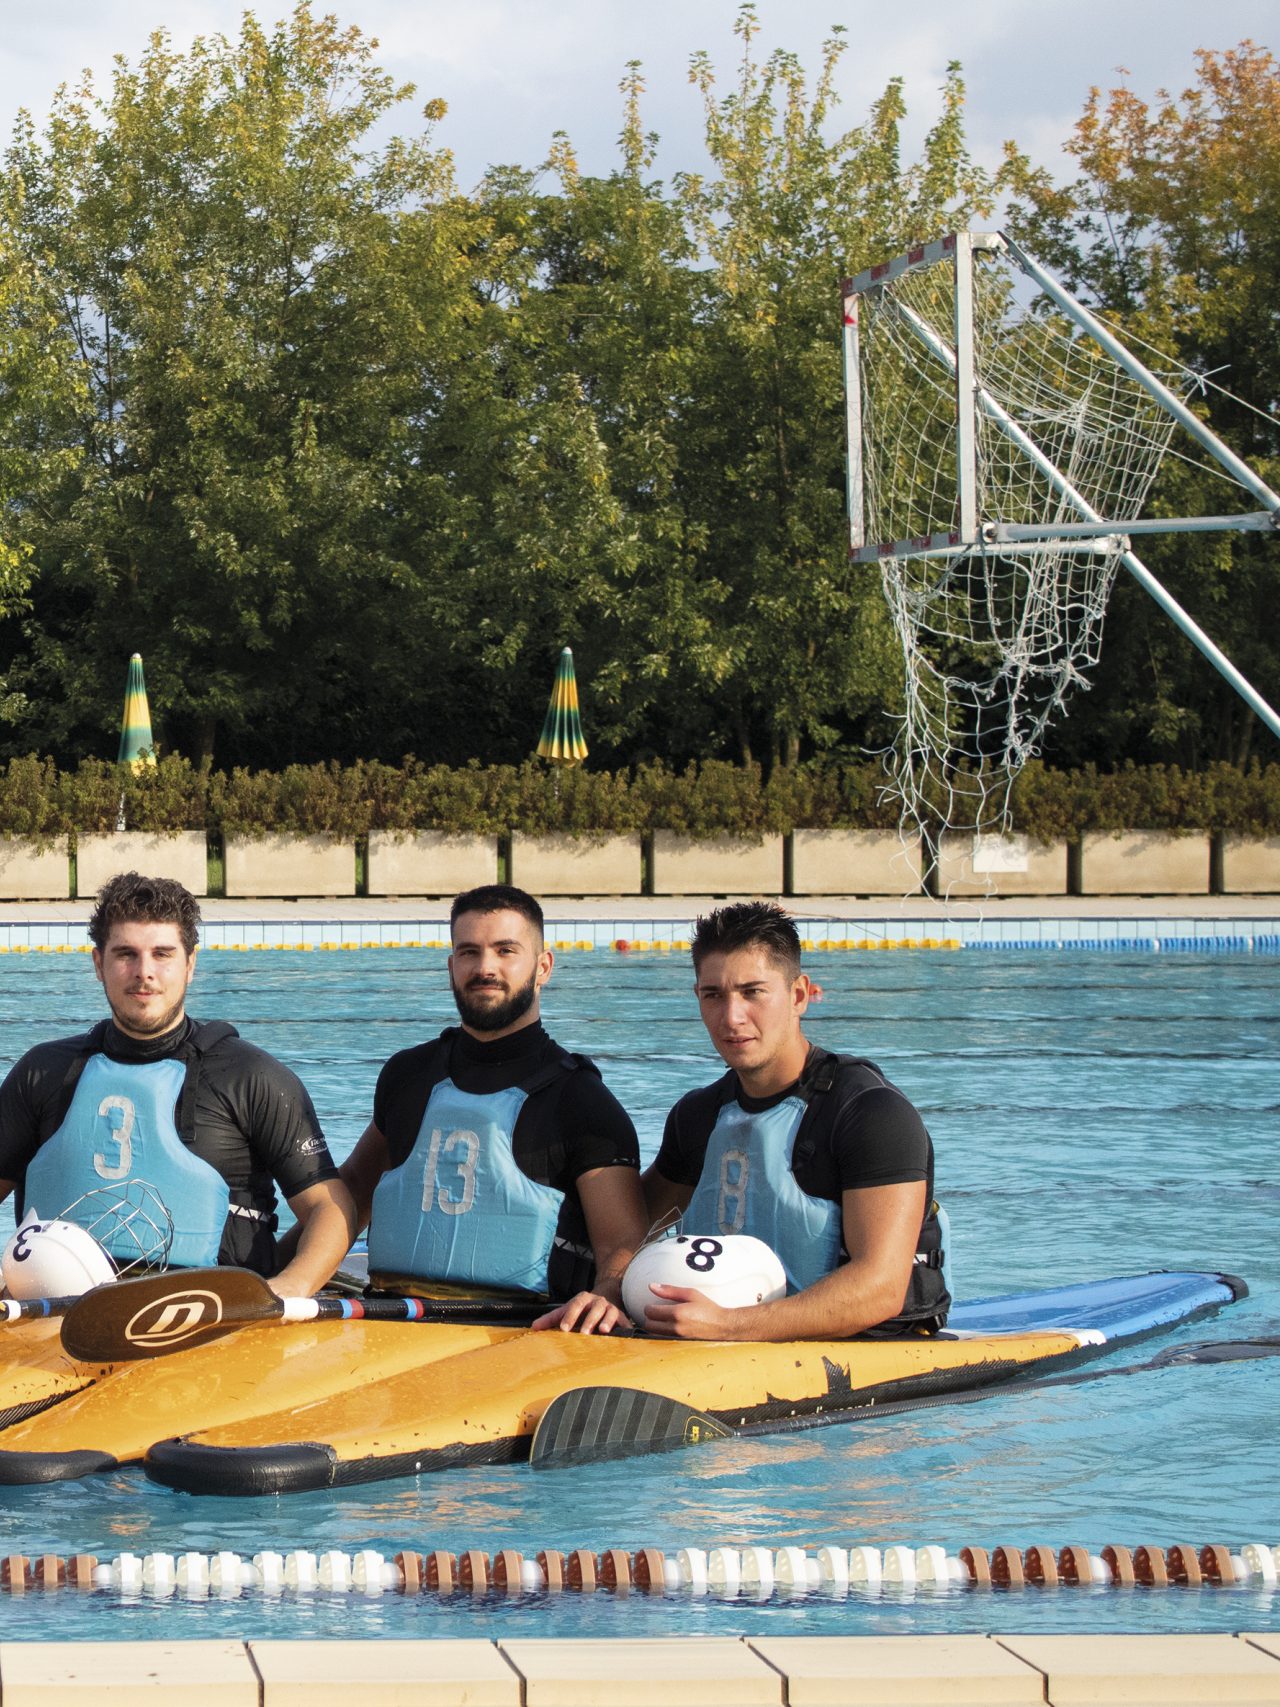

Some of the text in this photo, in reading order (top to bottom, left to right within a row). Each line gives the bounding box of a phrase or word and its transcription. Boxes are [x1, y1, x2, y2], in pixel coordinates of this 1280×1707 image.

[93, 1095, 135, 1179] 3
[421, 1129, 480, 1215] 13
[718, 1148, 749, 1236] 8
[13, 1224, 42, 1263] 3
[685, 1238, 723, 1273] 8
